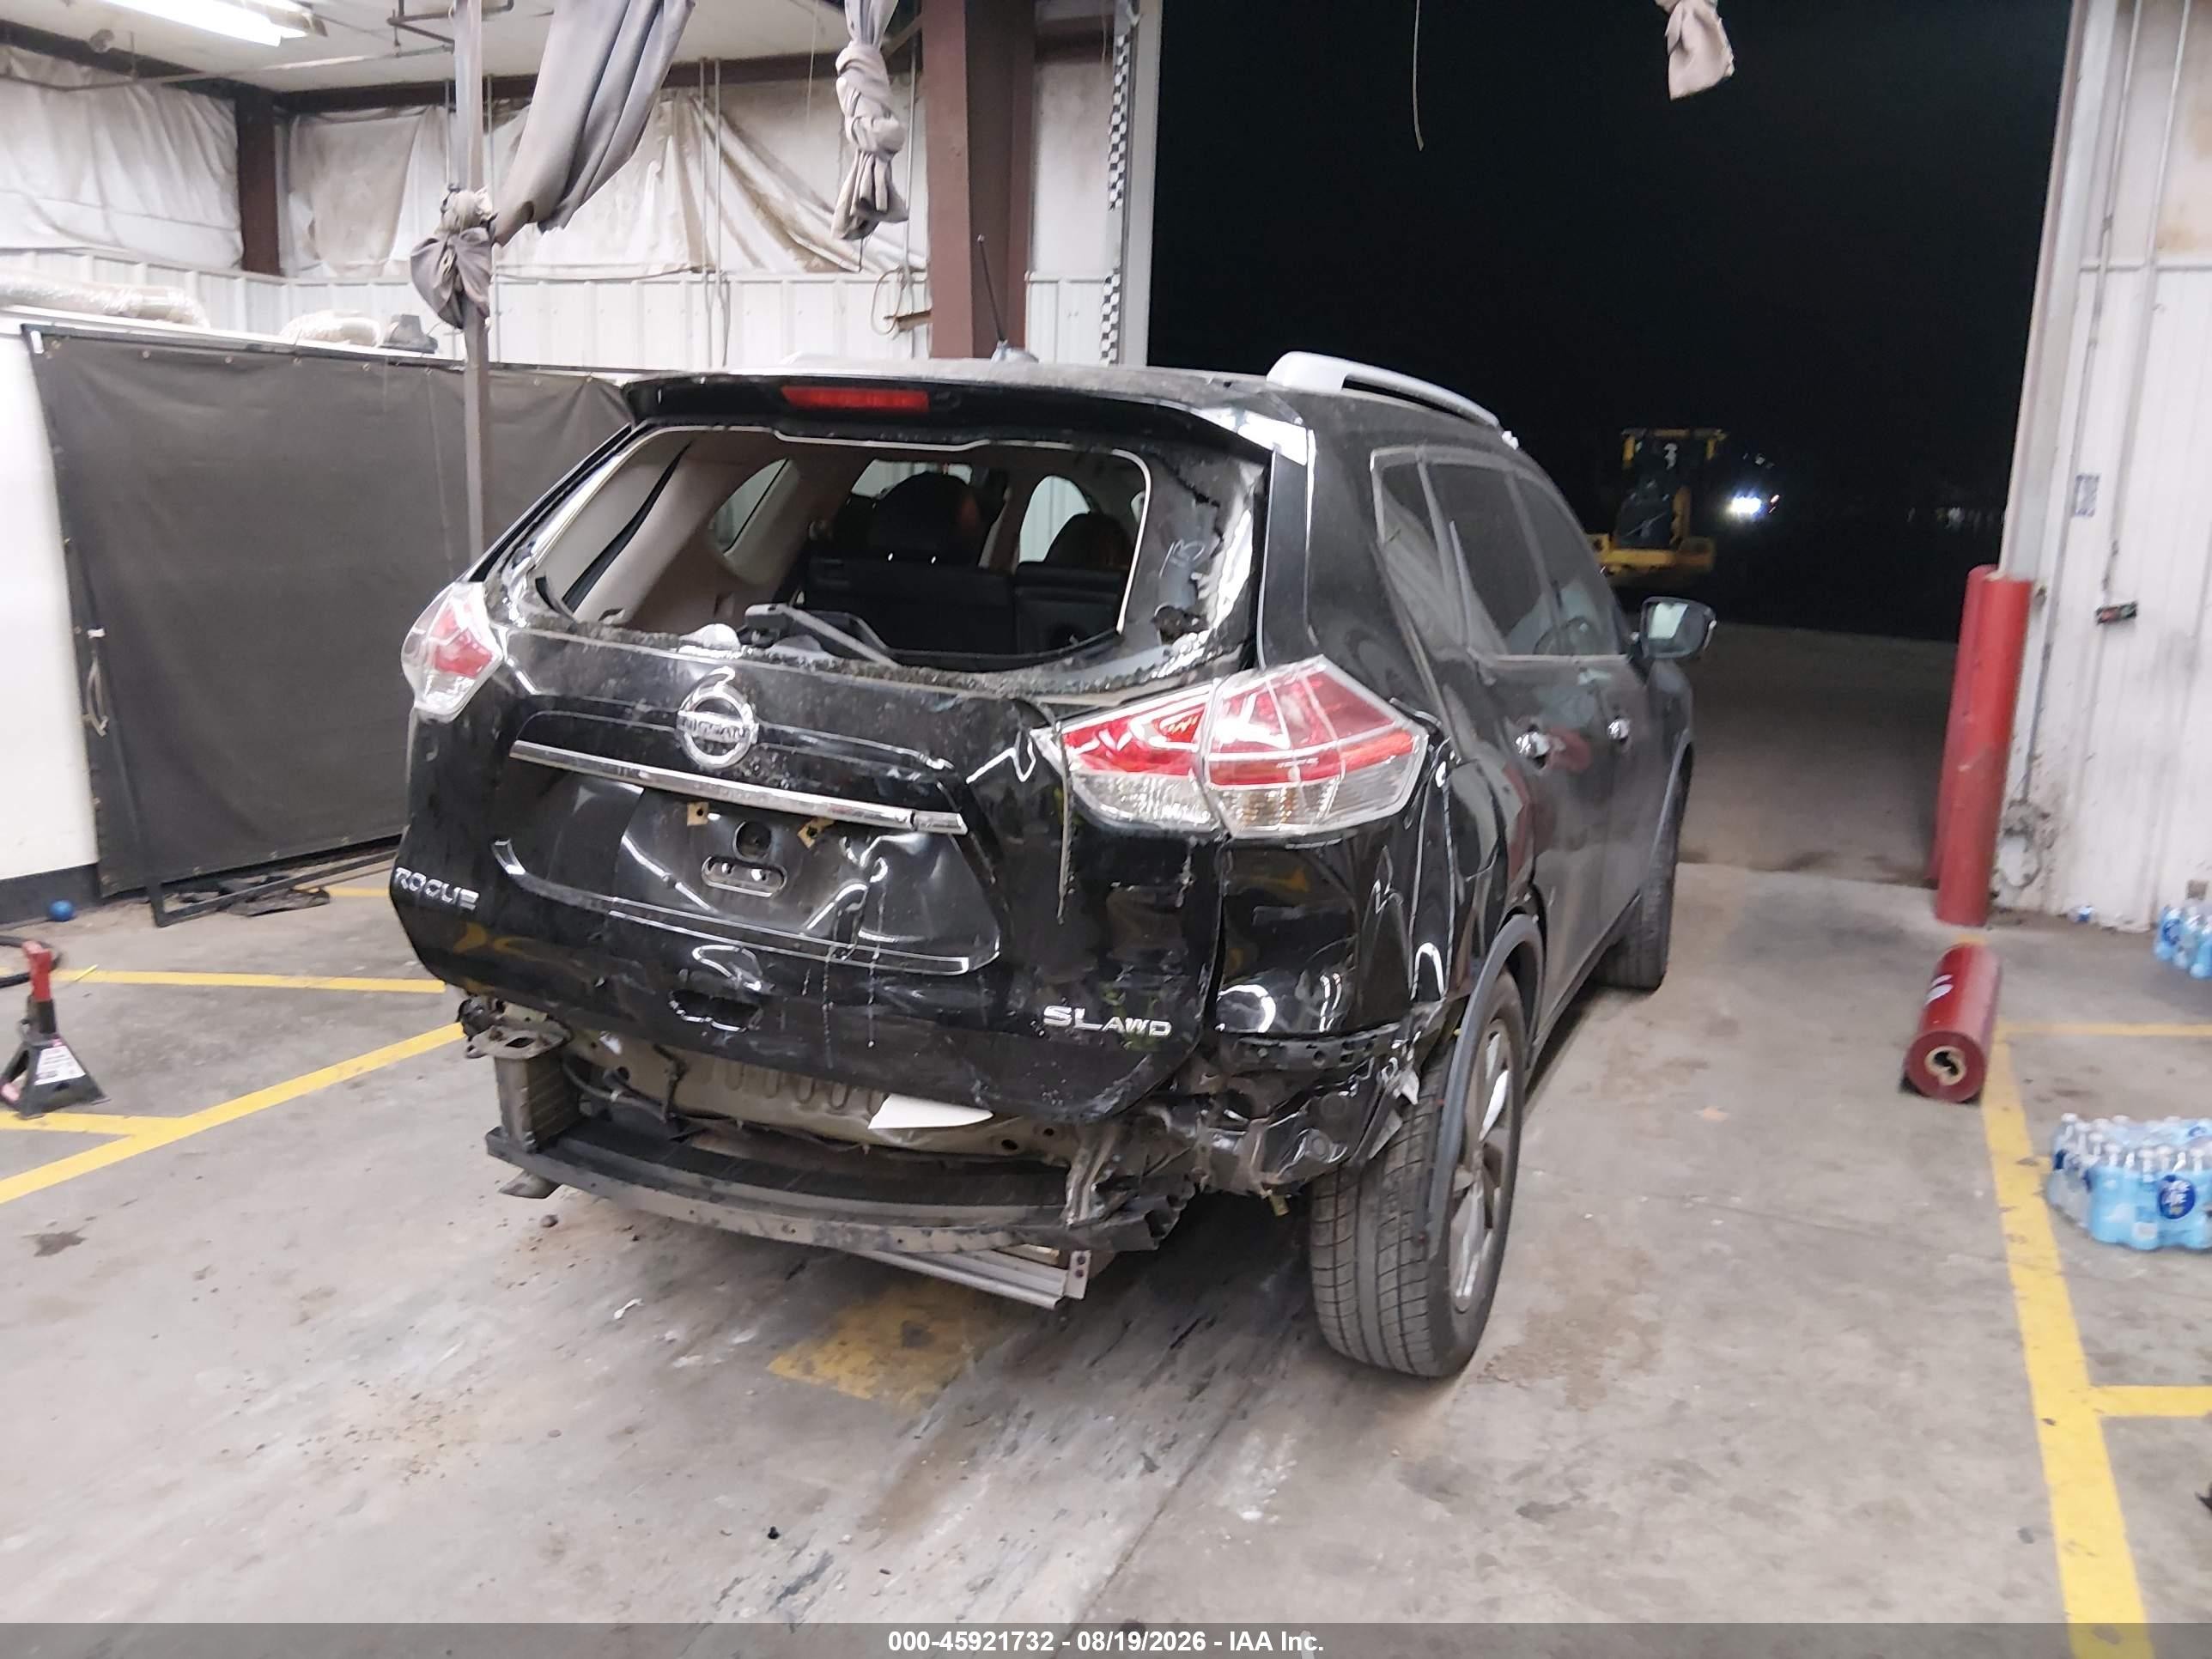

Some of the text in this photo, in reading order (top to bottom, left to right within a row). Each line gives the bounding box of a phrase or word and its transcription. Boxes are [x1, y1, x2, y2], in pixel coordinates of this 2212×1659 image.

[393, 866, 479, 911] ROGUE
[1042, 1005, 1172, 1037] SL AWD
